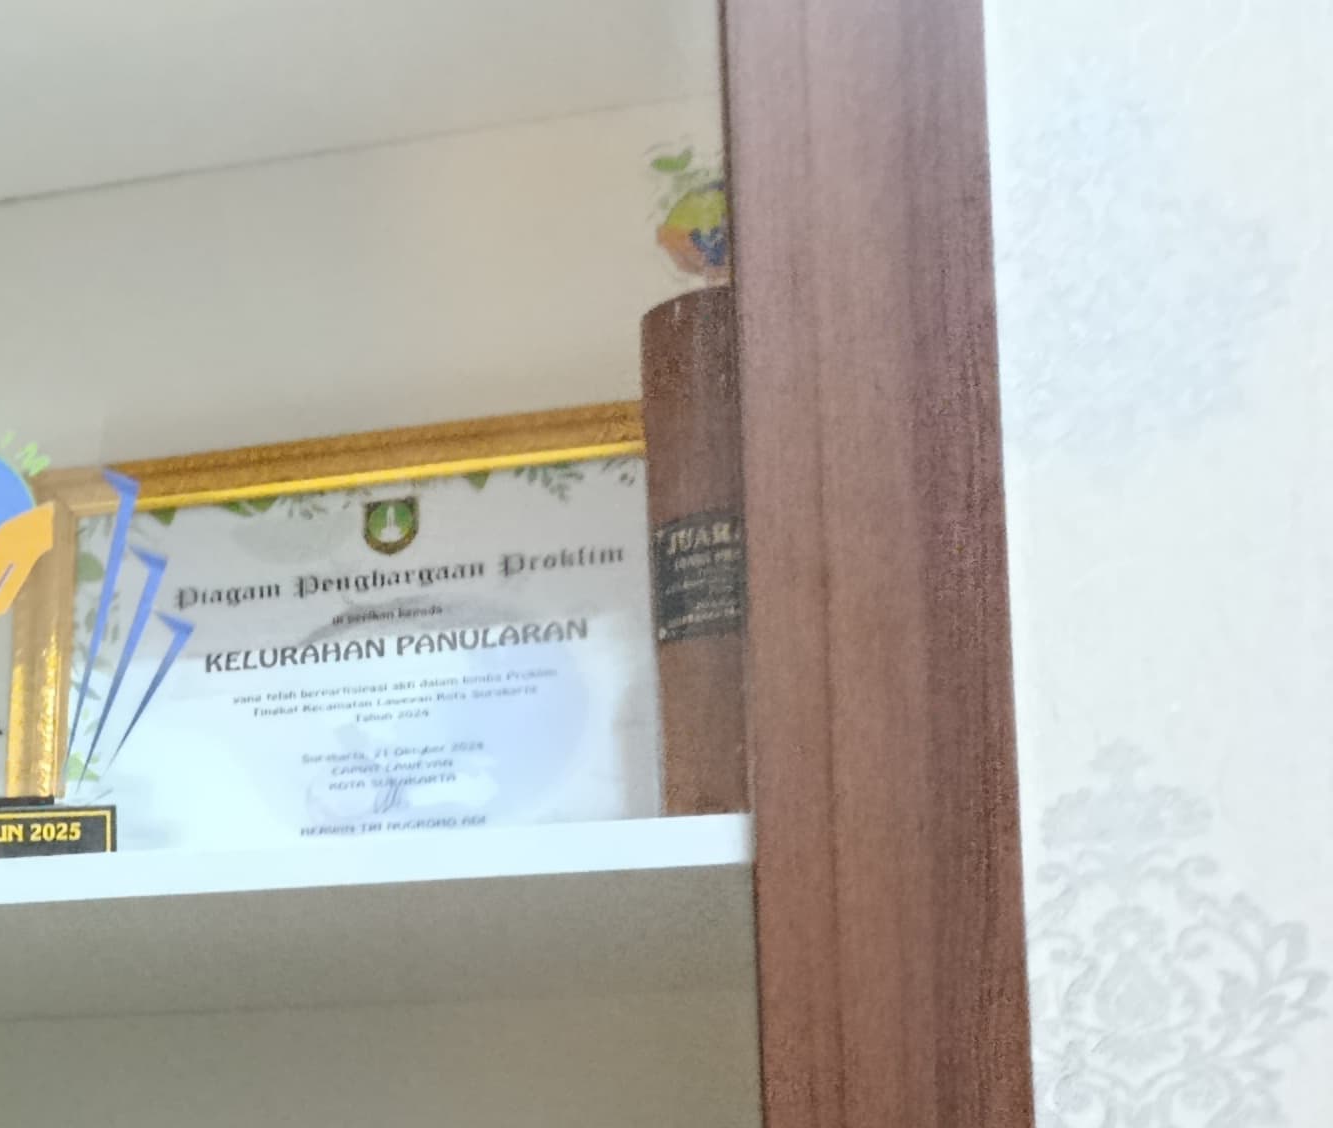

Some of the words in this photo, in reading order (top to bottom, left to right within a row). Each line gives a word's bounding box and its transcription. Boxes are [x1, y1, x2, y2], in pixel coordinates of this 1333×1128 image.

[176, 583, 281, 611] Piagam
[294, 562, 485, 599] Penghargaan
[500, 546, 624, 578] Proklim
[205, 638, 385, 673] KELURAHAN
[396, 618, 588, 656] PANULARAN
[30, 822, 82, 842] 2025
